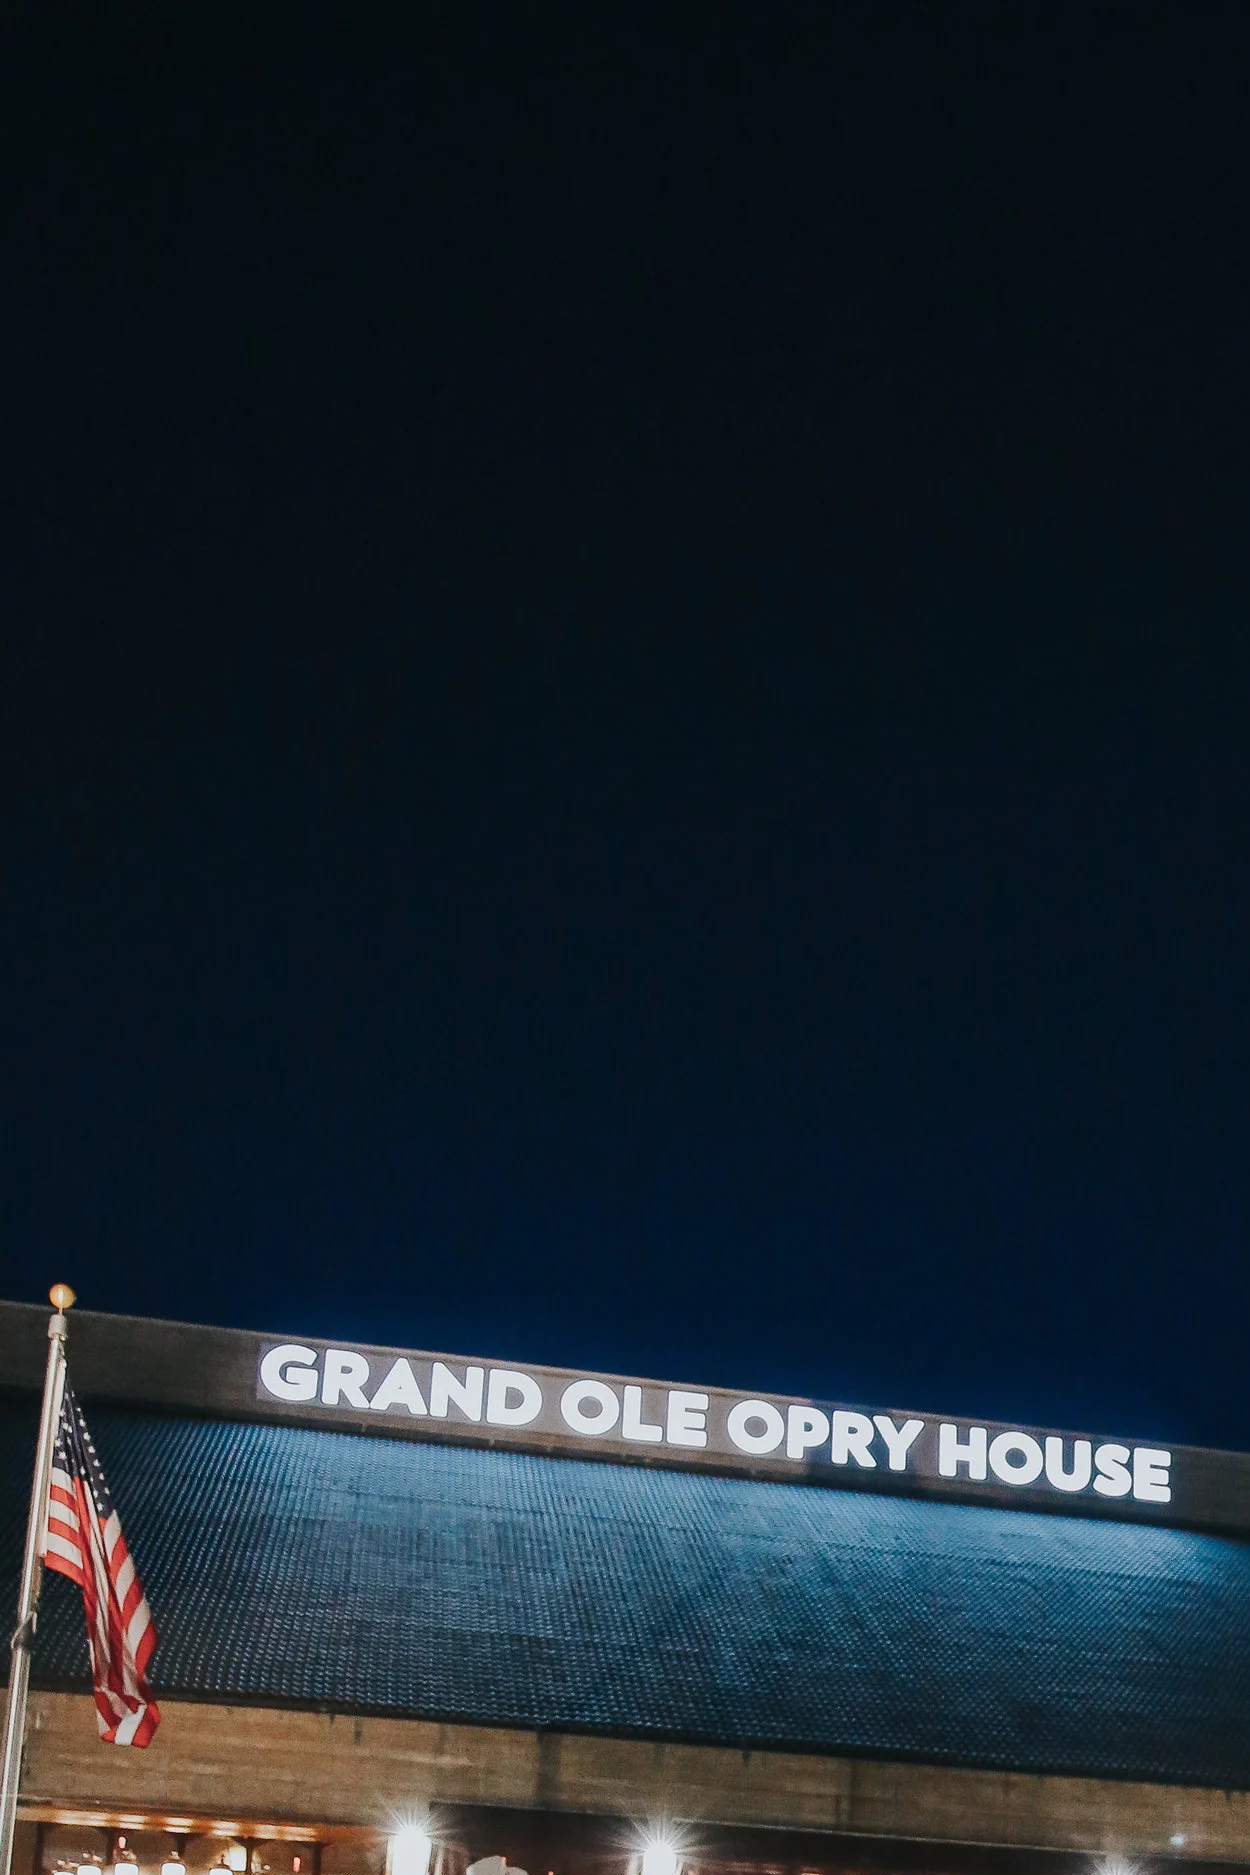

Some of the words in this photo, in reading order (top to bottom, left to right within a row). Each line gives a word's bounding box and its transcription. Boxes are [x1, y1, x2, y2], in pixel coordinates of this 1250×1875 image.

[260, 1344, 543, 1427] GRAND
[560, 1379, 709, 1448] OLE
[727, 1399, 925, 1472] OPRY
[939, 1423, 1171, 1503] HOUSE
